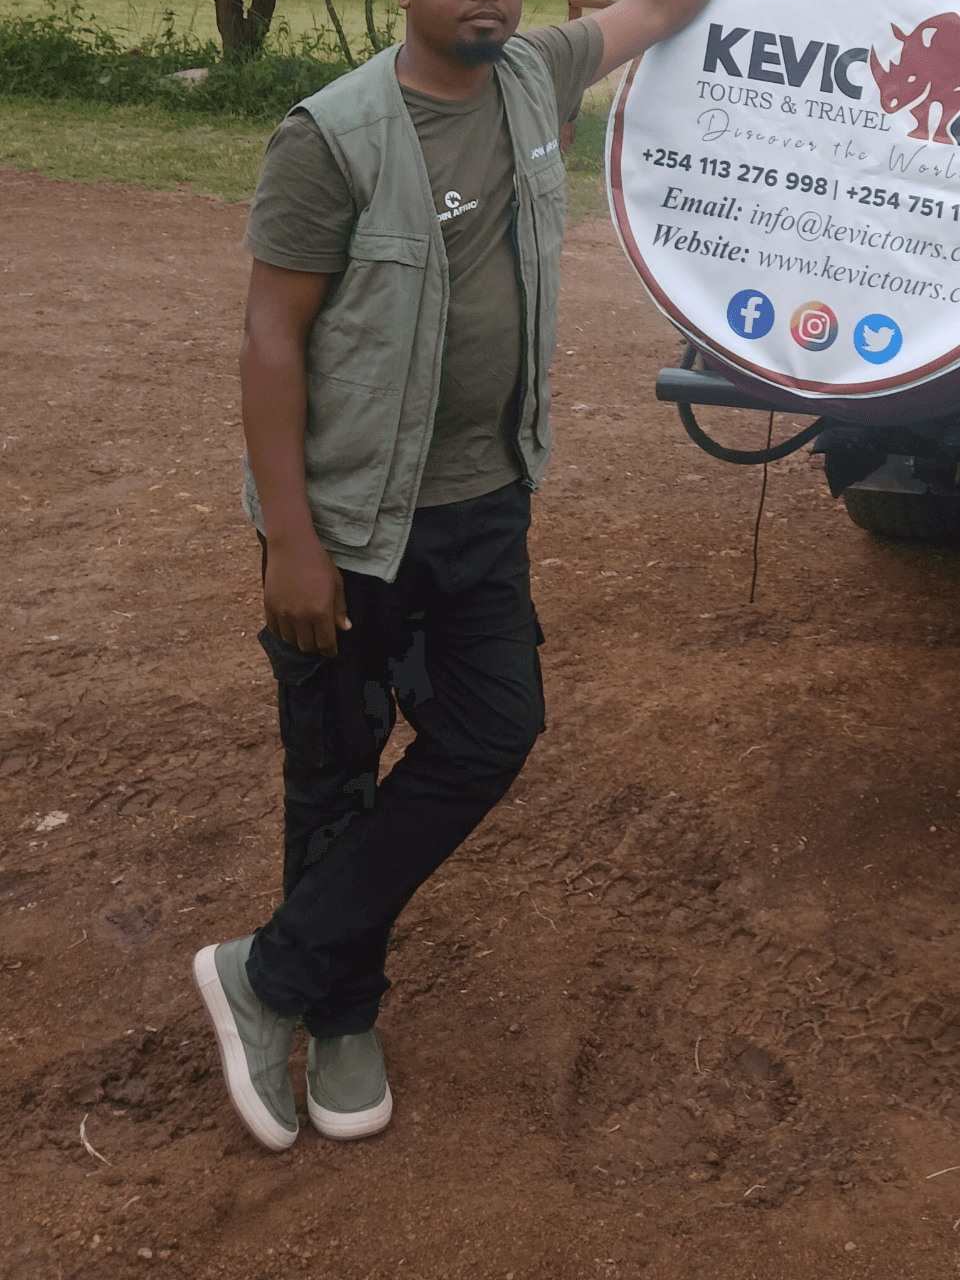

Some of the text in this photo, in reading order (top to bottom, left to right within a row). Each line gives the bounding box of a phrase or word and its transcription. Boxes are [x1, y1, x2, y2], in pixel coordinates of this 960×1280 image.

[703, 23, 870, 100] KEVIC
[697, 81, 891, 132] TOURS & TRAVEL
[697, 108, 818, 152] Discover
[833, 140, 868, 161] the
[642, 148, 692, 172] +254
[700, 157, 731, 179] 113
[737, 163, 778, 187] 276
[785, 172, 828, 196] 998
[846, 185, 900, 210] +254
[908, 194, 944, 219] 751
[660, 186, 743, 222] Email:
[652, 223, 750, 264] Website:
